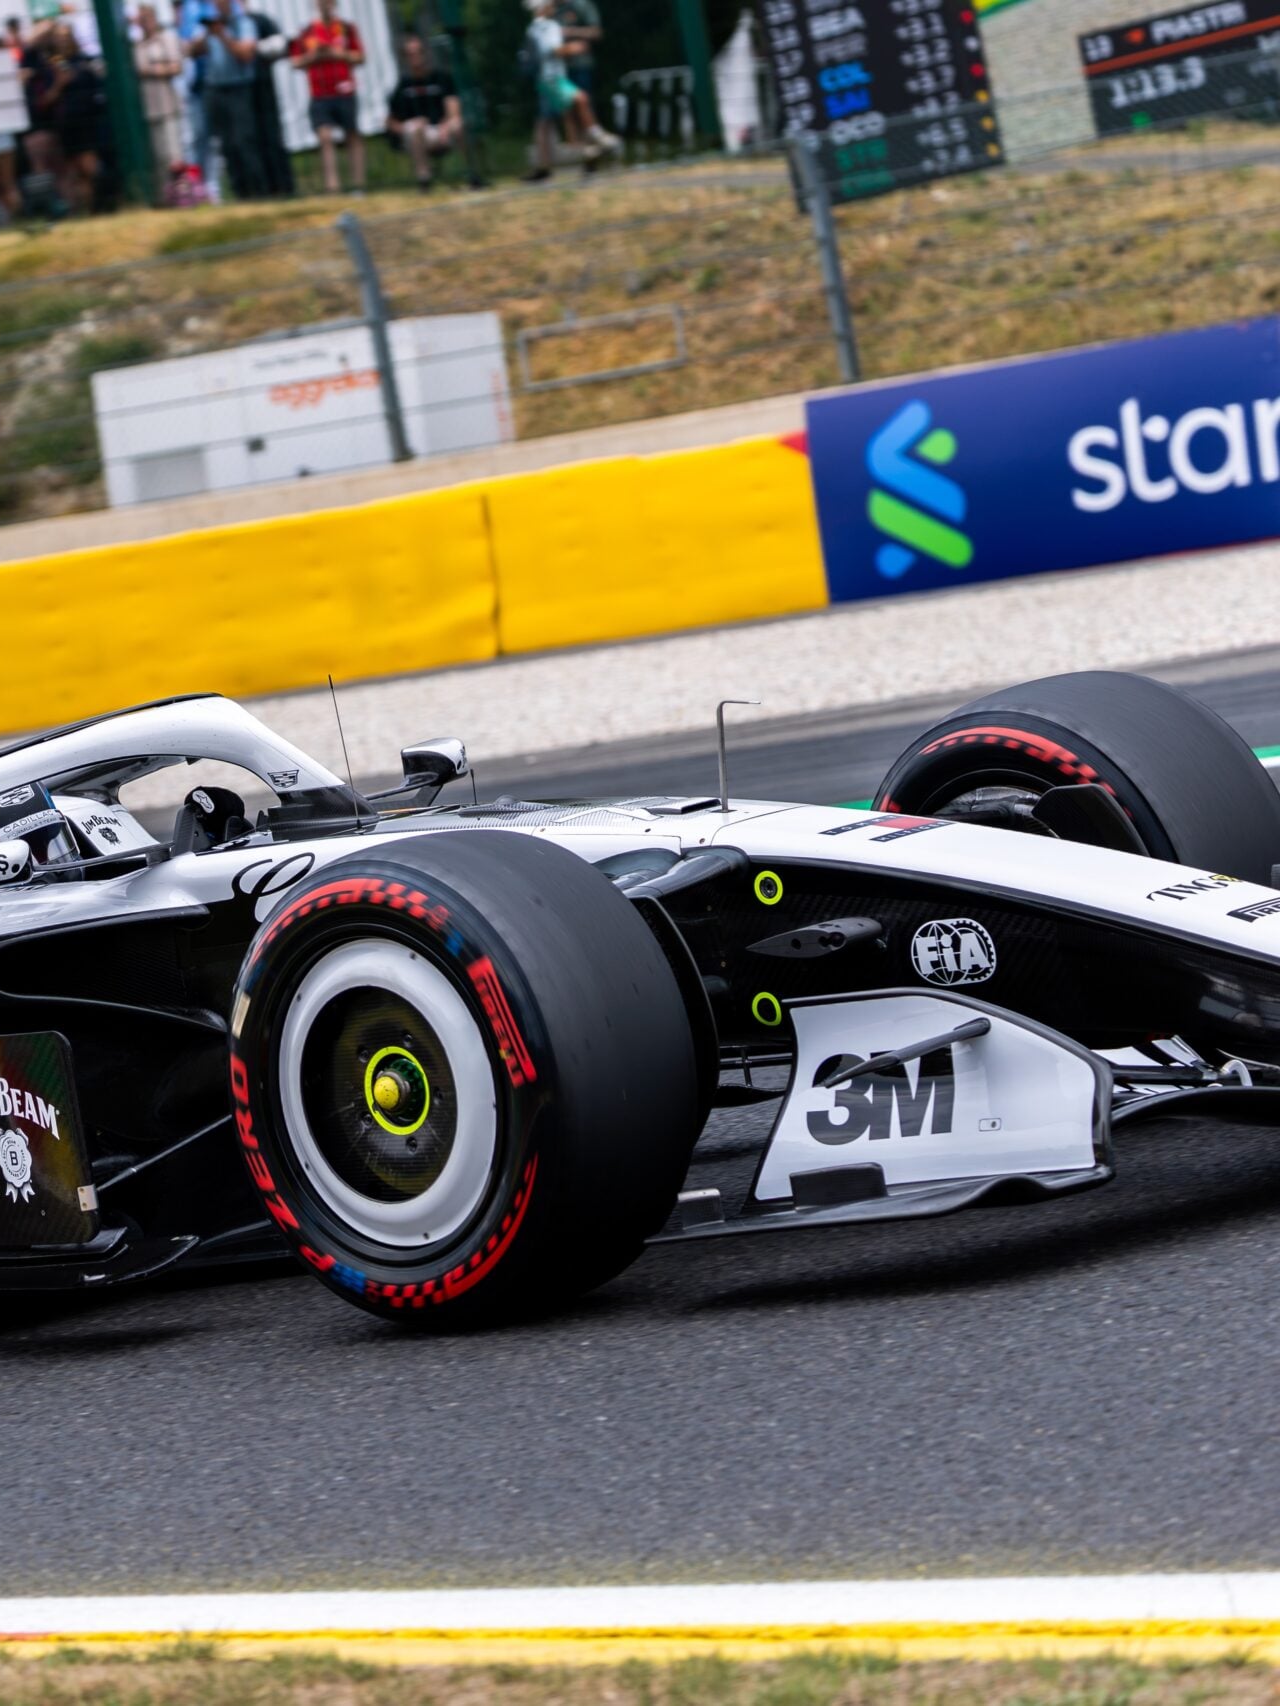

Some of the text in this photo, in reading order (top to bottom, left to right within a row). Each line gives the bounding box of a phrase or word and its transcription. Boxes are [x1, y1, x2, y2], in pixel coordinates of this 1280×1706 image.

[230, 1053, 300, 1233] ZERO
[806, 1044, 955, 1146] 3M
[10, 1151, 18, 1165] B
